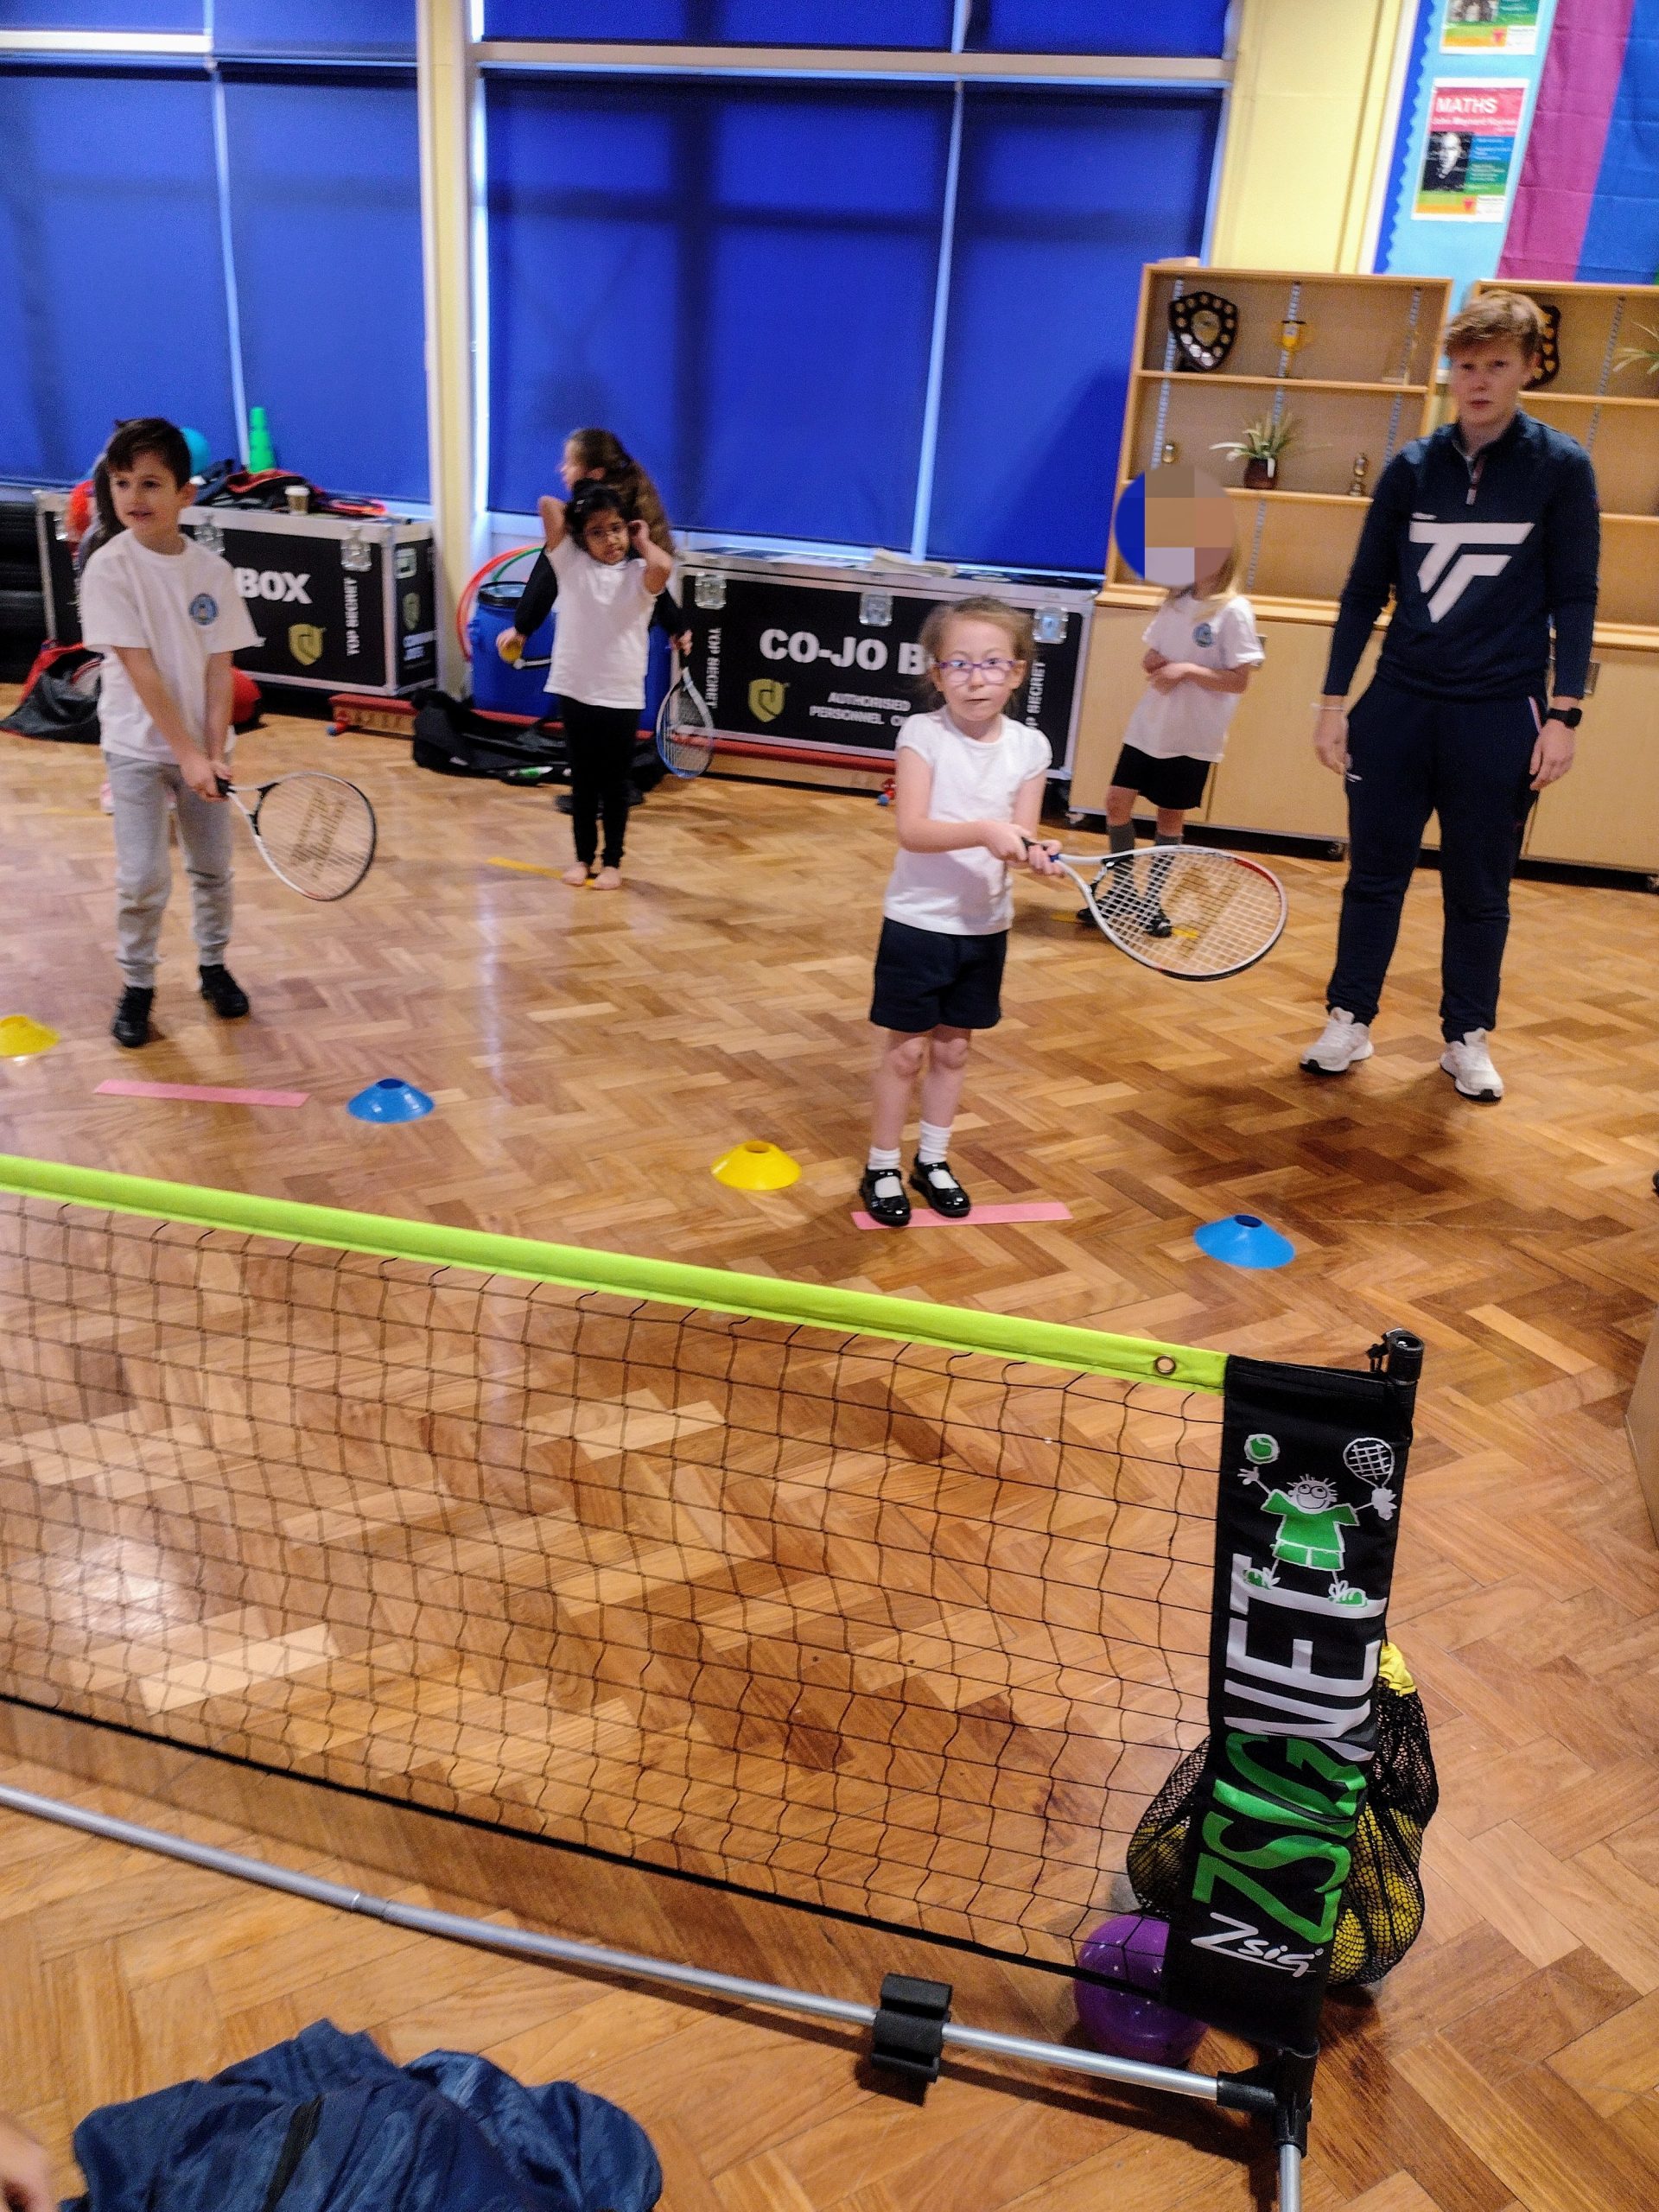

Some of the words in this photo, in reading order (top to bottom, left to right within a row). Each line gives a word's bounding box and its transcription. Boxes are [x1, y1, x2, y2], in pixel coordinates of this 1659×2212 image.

[1435, 97, 1497, 114] MATHS
[234, 566, 313, 605] BOX
[346, 629, 360, 656] TOP
[708, 628, 722, 654] TOP
[760, 628, 888, 671] CO-JO
[705, 657, 721, 709] SECRET
[827, 691, 912, 712] AUTHORISED
[809, 705, 885, 725] PERSONNEL
